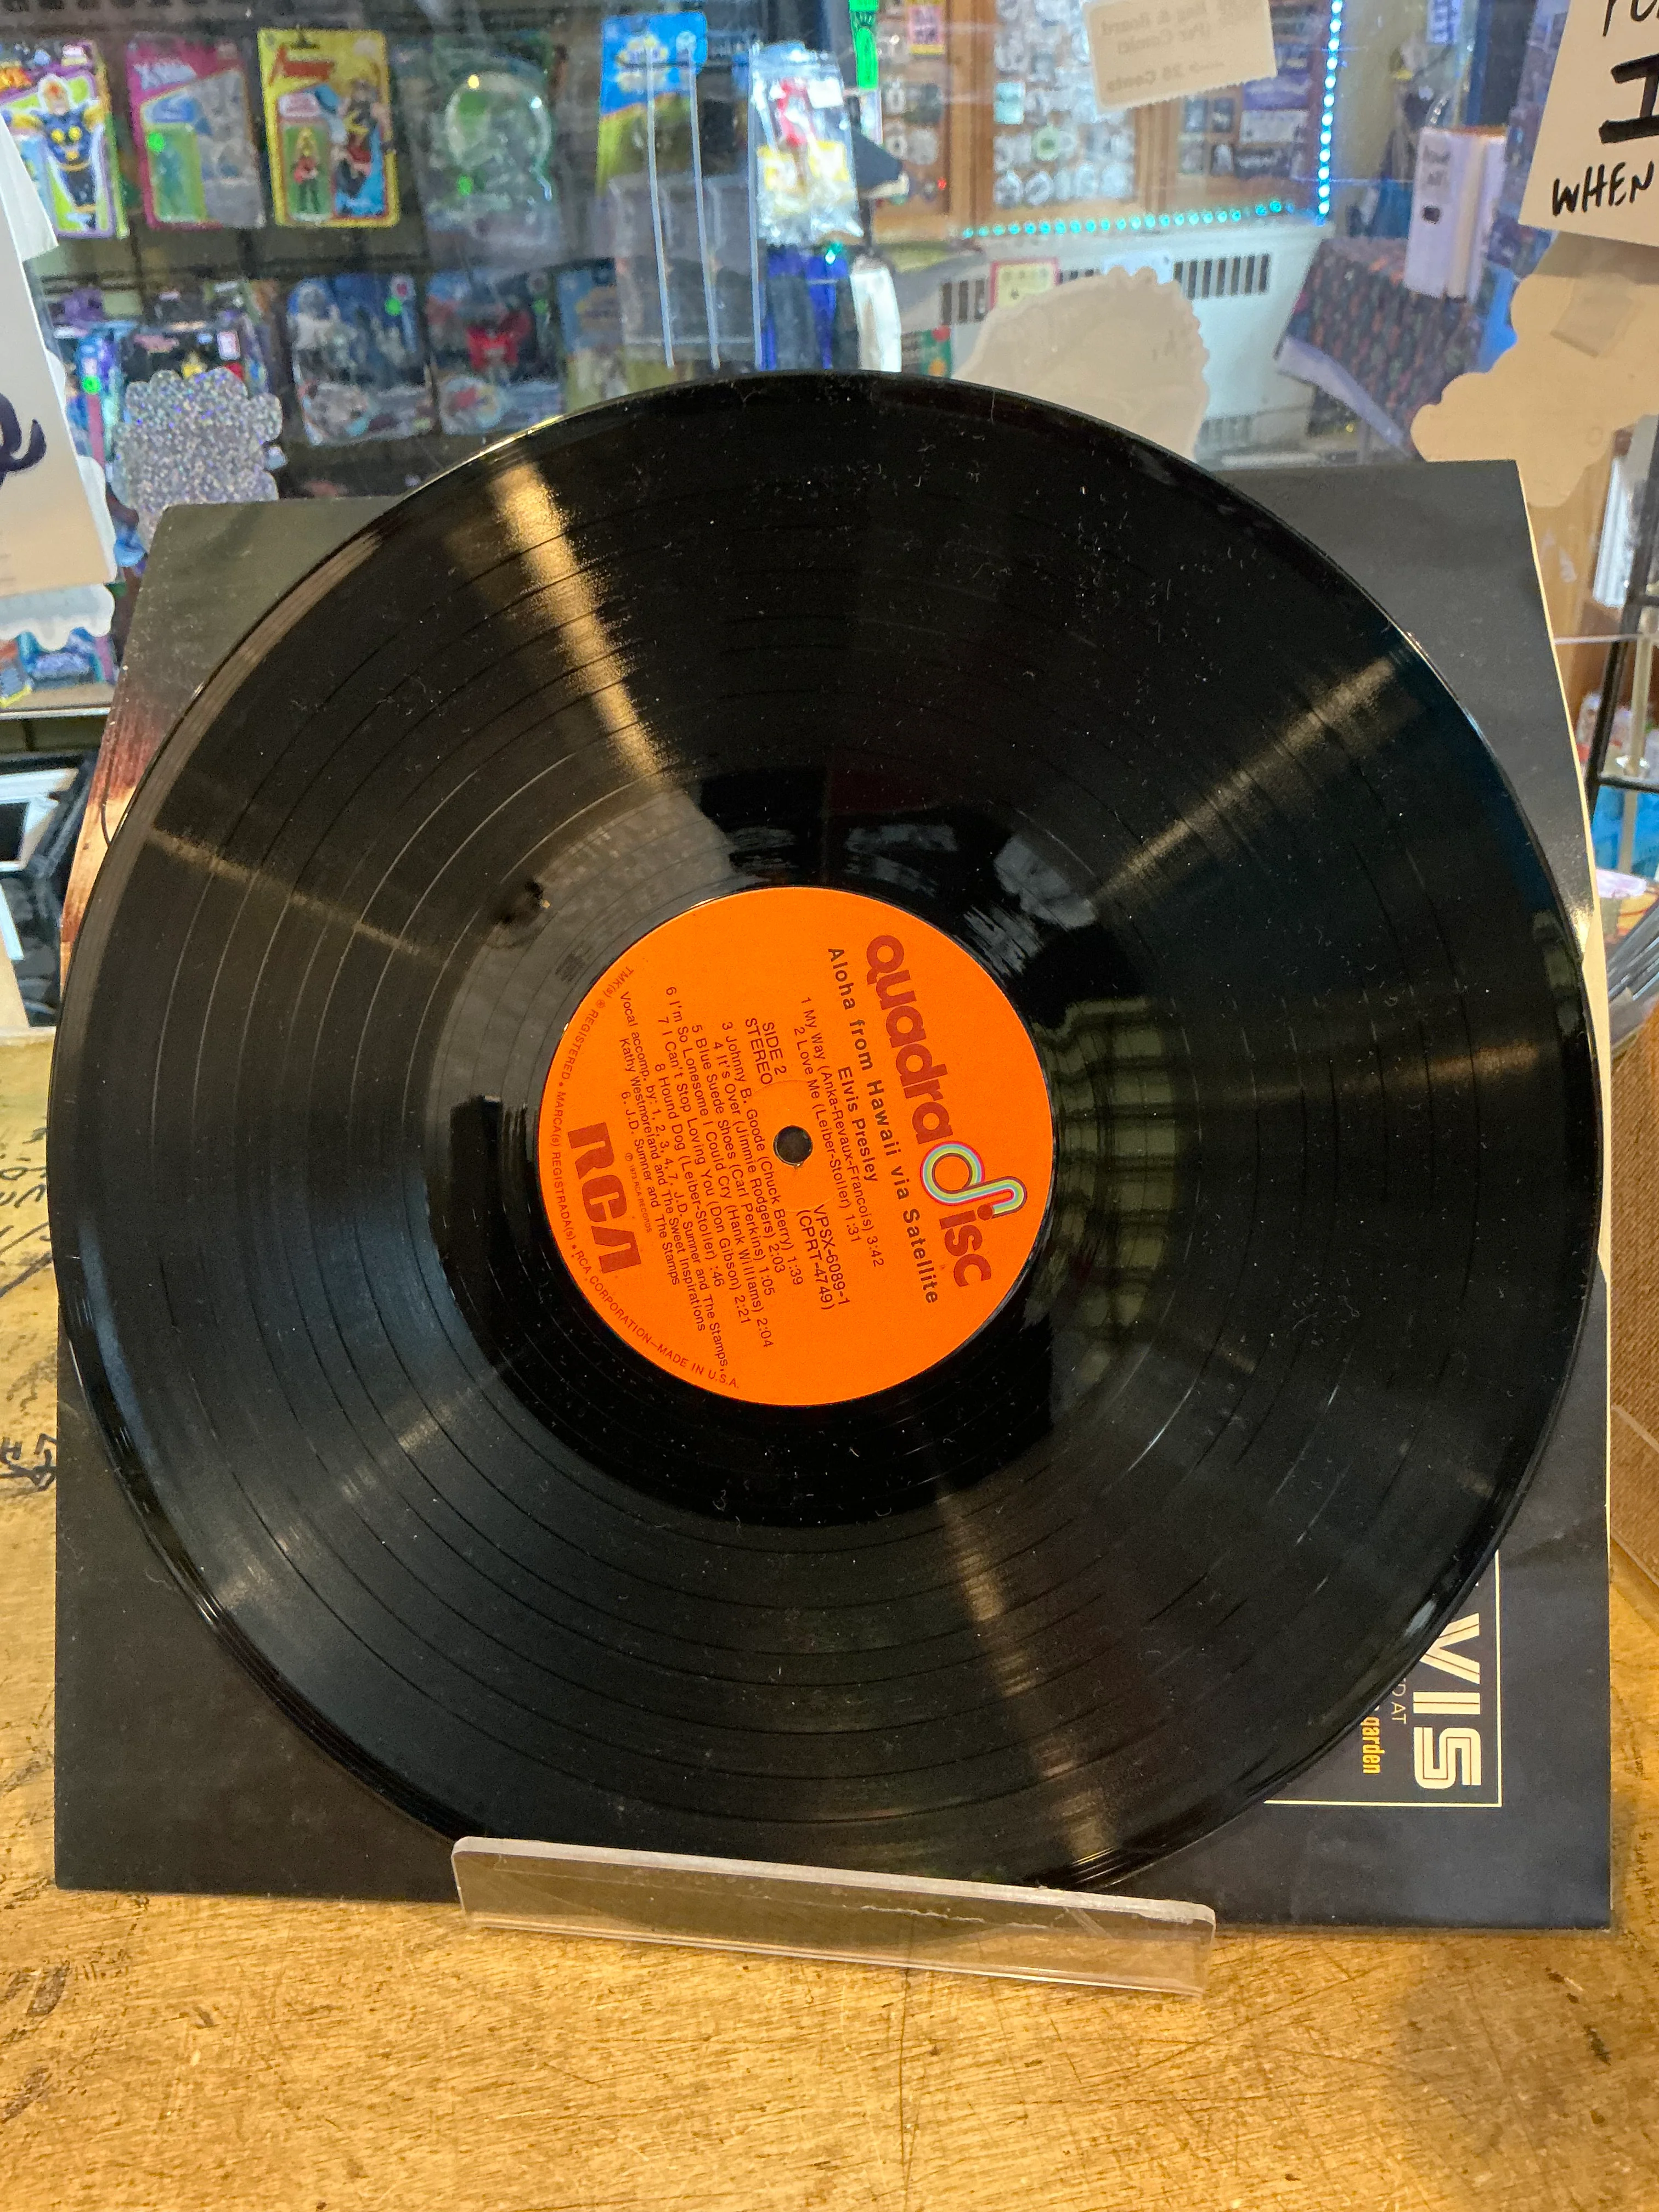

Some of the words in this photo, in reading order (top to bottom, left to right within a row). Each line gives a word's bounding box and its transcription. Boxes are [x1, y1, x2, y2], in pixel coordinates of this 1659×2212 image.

[1552, 160, 1655, 217] WHEN
[620, 991, 638, 1026] Vocal
[669, 1000, 682, 1022] I'm
[803, 1009, 817, 1028] My
[561, 1009, 599, 1079] REGISTERED
[677, 1026, 689, 1042] So
[744, 1017, 772, 1085] STEREO
[761, 1022, 783, 1060] SIDE
[811, 1032, 826, 1059] Way
[631, 1031, 650, 1081] accomp.
[664, 1041, 684, 1078] Can't
[716, 1054, 730, 1079] It's
[796, 1040, 813, 1075] Love
[646, 1084, 657, 1104] by:
[676, 1083, 691, 1112] Stop
[682, 1047, 708, 1116] Lonesome
[724, 1083, 741, 1114] Over
[806, 1079, 820, 1099] Me
[687, 1117, 706, 1165] Loving
[827, 948, 855, 1010] Aloha
[849, 1019, 873, 1070] from
[866, 1079, 901, 1156] Hawaii
[890, 1165, 910, 1199] via
[902, 1208, 938, 1303] Satellite
[837, 1066, 859, 1112] Elvis
[851, 1118, 878, 1181] Presley
[695, 1037, 712, 1070] Blue
[706, 1073, 725, 1114] Suede
[717, 1119, 736, 1159] Shoes
[728, 1164, 749, 1197] (Carl
[741, 1203, 766, 1261] Perkins)
[759, 1266, 775, 1295] 1:05
[706, 1131, 727, 1171] Could
[725, 1035, 747, 1081] Johnny
[740, 1087, 752, 1103] B.
[746, 1109, 765, 1151] Goode
[757, 1156, 781, 1204] (Chuck
[773, 1208, 794, 1250] Berry)
[787, 1256, 803, 1285] 1:39
[732, 1120, 757, 1172] (Jimmie
[811, 1103, 851, 1208] (Leiber-Stoller)
[817, 1065, 874, 1231] (Anka-Revaux-Francois)
[619, 1037, 636, 1072] Kathy
[630, 1075, 661, 1159] Westmoreland
[654, 1164, 668, 1186] and
[661, 1188, 673, 1214] The
[668, 1217, 686, 1254] Sweet
[679, 1257, 705, 1331] Inspirations
[658, 1076, 680, 1119] Hound
[671, 1123, 685, 1150] Dog
[678, 1155, 718, 1260] (Leiber-Stoller)
[700, 1169, 715, 1196] You
[718, 1175, 732, 1198] Cry
[567, 1122, 641, 1273] RCA
[625, 1109, 639, 1134] J.D.
[634, 1138, 652, 1180] Sumner
[647, 1186, 661, 1207] and
[654, 1213, 667, 1238] The
[662, 1242, 680, 1285] Stamps
[674, 1192, 687, 1217] J.D.
[706, 1200, 725, 1233] (Don
[749, 1177, 776, 1238] Rodgers)
[682, 1221, 701, 1263] Sumner
[724, 1205, 745, 1245] (Hank
[845, 1214, 861, 1242] 1:31
[719, 1238, 742, 1290] Gibson)
[768, 1243, 785, 1273] 2:03
[795, 1210, 836, 1310] (CPRT-4749)
[813, 1204, 850, 1305] VPSX-6089-1
[866, 1235, 884, 1267] 3:42
[696, 1268, 710, 1290] and
[738, 1248, 764, 1312] Williams)
[574, 1250, 591, 1274] RCA
[691, 1363, 704, 1375] IN
[708, 1369, 738, 1388] U.S.A.
[702, 1294, 715, 1318] The
[734, 1295, 751, 1323] 2:21
[709, 1322, 728, 1371] Stamps,
[756, 1317, 774, 1347] 2:04
[1391, 1701, 1407, 1725] AT
[1413, 1613, 1482, 1789] VIS
[1360, 1716, 1385, 1774] garden
